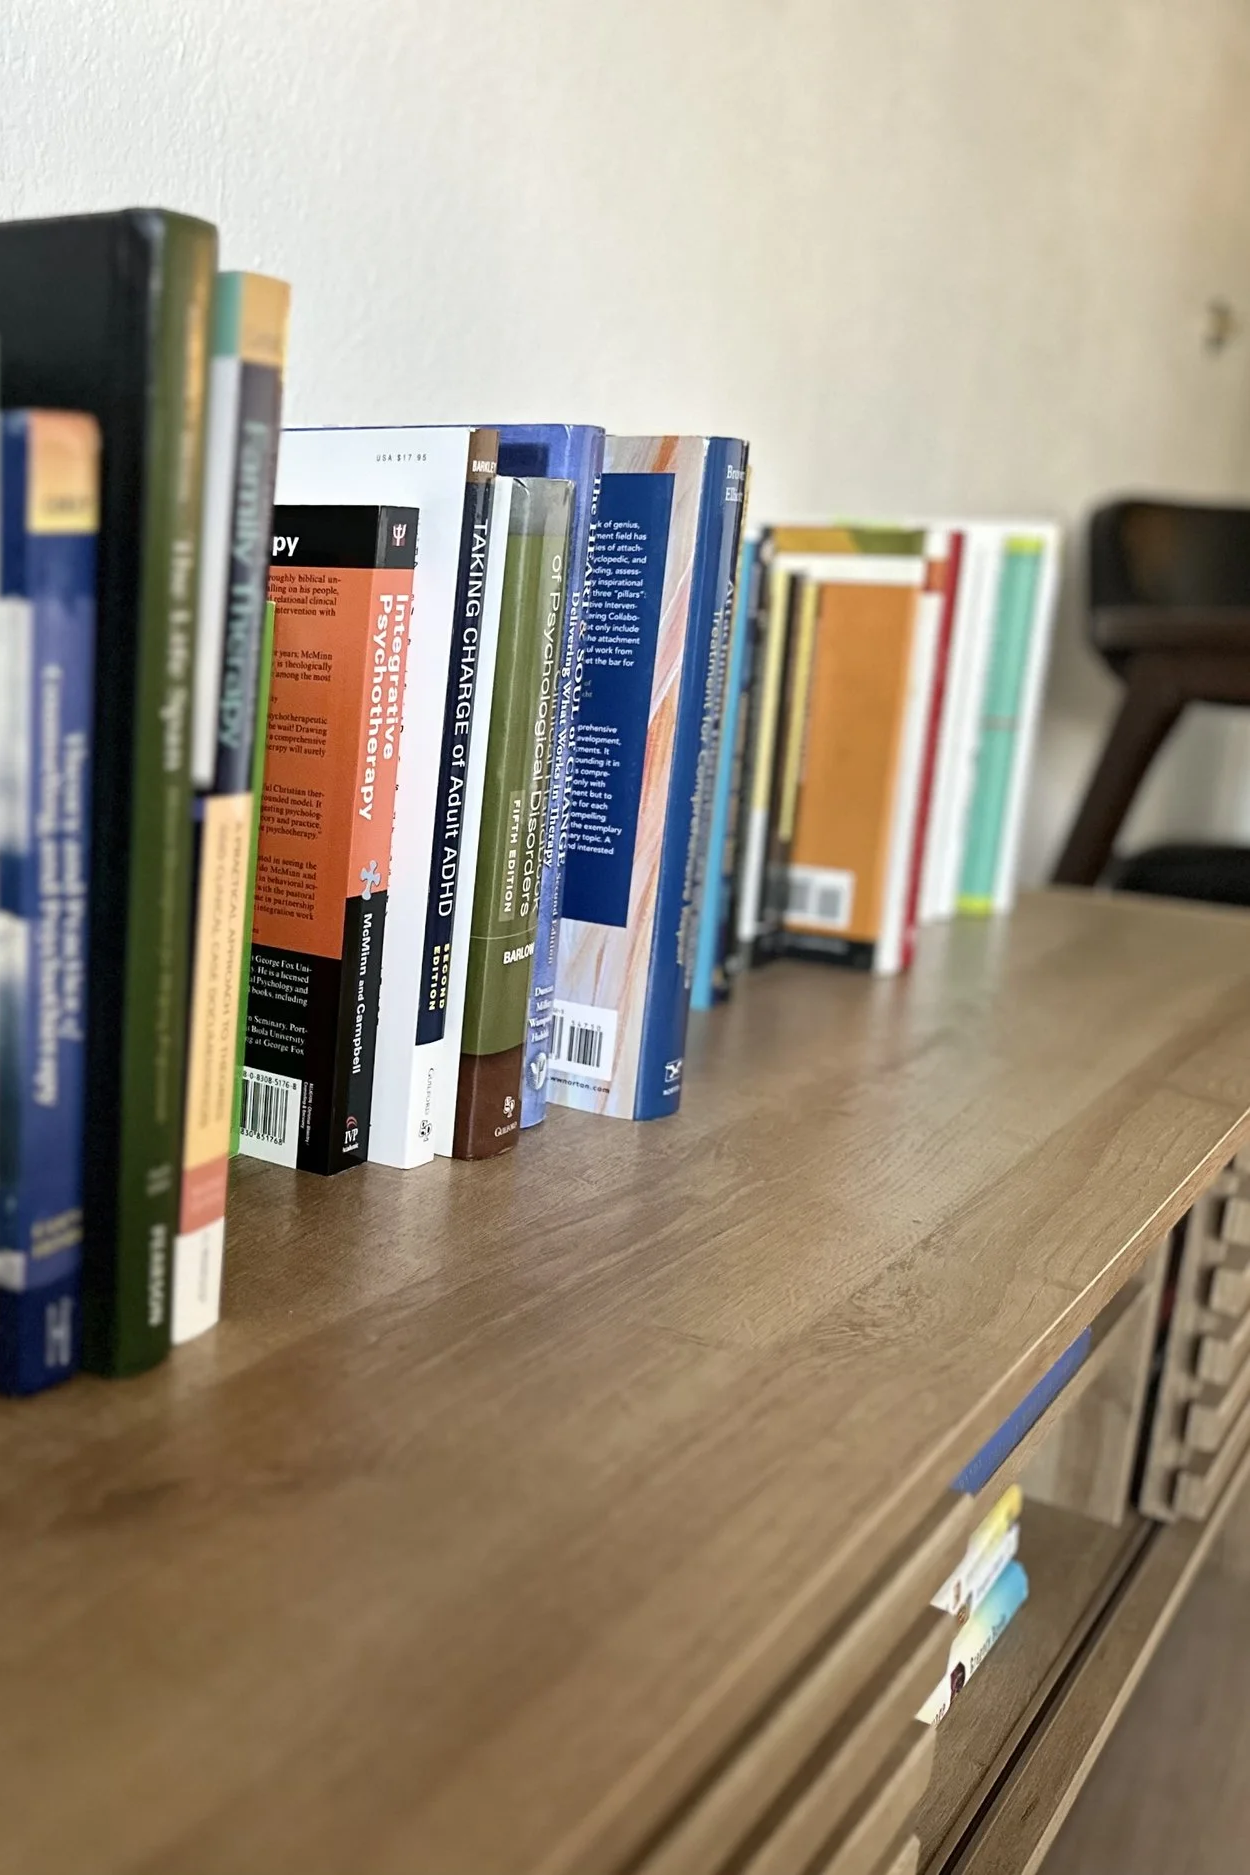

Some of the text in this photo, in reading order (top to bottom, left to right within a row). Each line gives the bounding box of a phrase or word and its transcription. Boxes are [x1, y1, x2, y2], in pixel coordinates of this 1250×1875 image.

[376, 453, 392, 462] USA
[590, 473, 601, 515] The
[604, 520, 640, 531] of genius,
[615, 531, 647, 541] field has
[272, 535, 299, 557] py
[607, 543, 644, 552] of attach-
[631, 556, 647, 564] and
[581, 522, 597, 614] HEART
[298, 573, 325, 584] biblical
[598, 578, 644, 588] inspirational
[300, 585, 311, 594] his
[592, 589, 612, 597] three
[309, 596, 337, 606] clinical
[604, 601, 639, 610] Interven-
[319, 607, 336, 617] with
[608, 612, 641, 622] Collabo-
[595, 624, 640, 633] only include
[597, 635, 641, 645] attachment
[301, 650, 333, 660] McMinn
[595, 646, 633, 655] work from
[218, 585, 254, 750] Therapy
[285, 660, 332, 673] theologically
[595, 657, 635, 667] the bar for
[275, 672, 331, 682] among the most
[383, 594, 409, 760] Integrative
[570, 648, 585, 721] SOUL
[358, 594, 393, 821] Psychotherapy
[268, 714, 328, 725] sychotherapeutic
[438, 518, 488, 917] TAKING CHARGE of Adult ADHD
[296, 725, 327, 737] Drawing
[543, 591, 581, 868] Delivering What Works in Therapy
[577, 723, 618, 734] prehensive
[275, 734, 327, 746] comprehensive
[520, 554, 562, 918] of Psychological Disorders
[289, 745, 327, 758] will surely
[605, 758, 620, 767] it in
[580, 768, 610, 778] compre-
[590, 780, 606, 788] with
[273, 784, 326, 798] Christian ther-
[589, 790, 613, 800] but to
[316, 801, 323, 809] It
[556, 756, 576, 867] CHANGE
[578, 800, 608, 811] for each
[285, 807, 323, 820] psycholog-
[571, 811, 607, 822] ompelling
[276, 816, 289, 825] and
[570, 821, 622, 835] the exemplary
[577, 842, 615, 855] interested
[503, 799, 521, 913] FIFTH EDITION
[273, 857, 317, 870] in seeing the
[227, 835, 243, 921] PRACTICAL
[270, 866, 317, 880] McMinn and
[267, 876, 304, 888] behavioral
[273, 887, 315, 901] the pastoral
[273, 897, 315, 911] partnership
[257, 904, 314, 920] integration work
[503, 942, 535, 965] BARLOW
[255, 954, 313, 973] George Fox Uni-
[257, 966, 309, 984] He licensed
[428, 945, 441, 1011] EDITION
[438, 943, 450, 1010] SECOND
[256, 976, 309, 995] Psychology and
[275, 992, 308, 1007] including
[352, 912, 373, 1075] McMinn and Campbell
[289, 1022, 309, 1034] Port-
[251, 1025, 306, 1046] Biola University
[263, 1038, 305, 1055] George Fox
[256, 1132, 284, 1146] 851768
[344, 1127, 359, 1145] IVP
